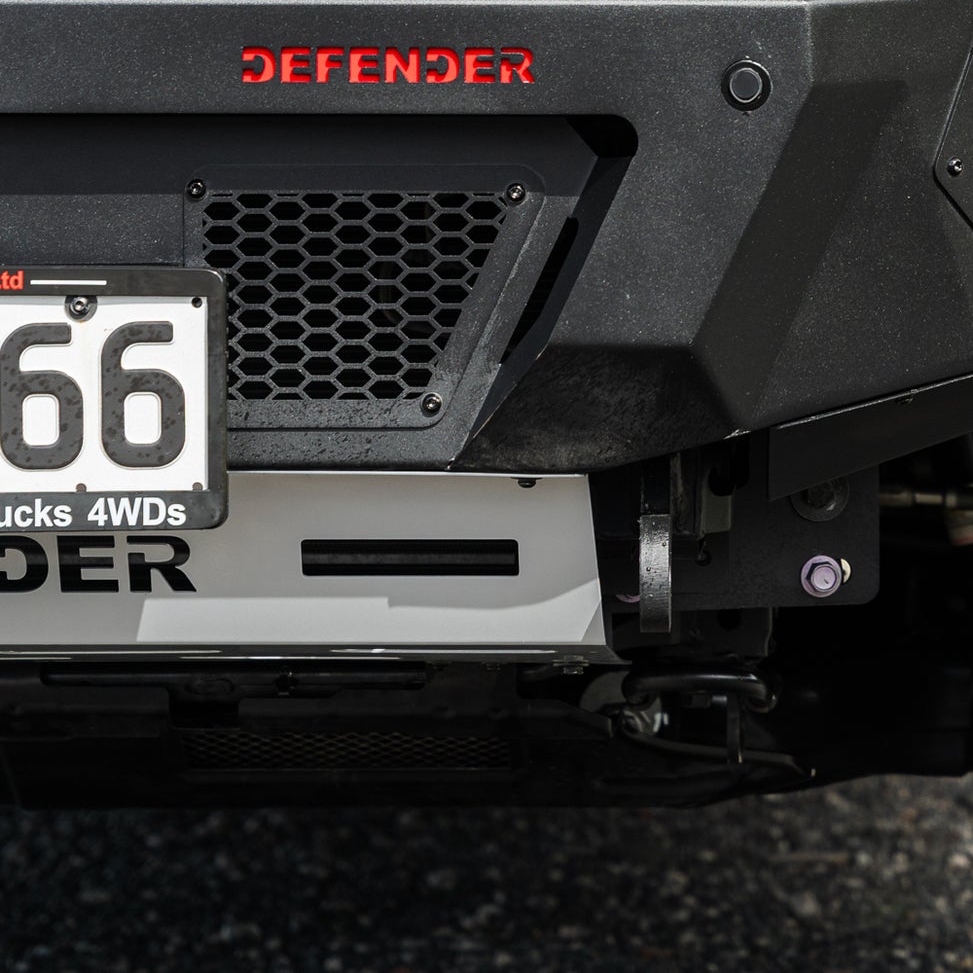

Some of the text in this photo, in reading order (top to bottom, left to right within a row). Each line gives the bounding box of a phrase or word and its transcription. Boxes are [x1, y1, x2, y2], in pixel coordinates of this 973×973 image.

[241, 46, 535, 84] DEFENDER
[0, 269, 24, 291] td
[0, 321, 186, 470] 66
[87, 497, 187, 527] 4WDs
[0, 535, 197, 593] DER
